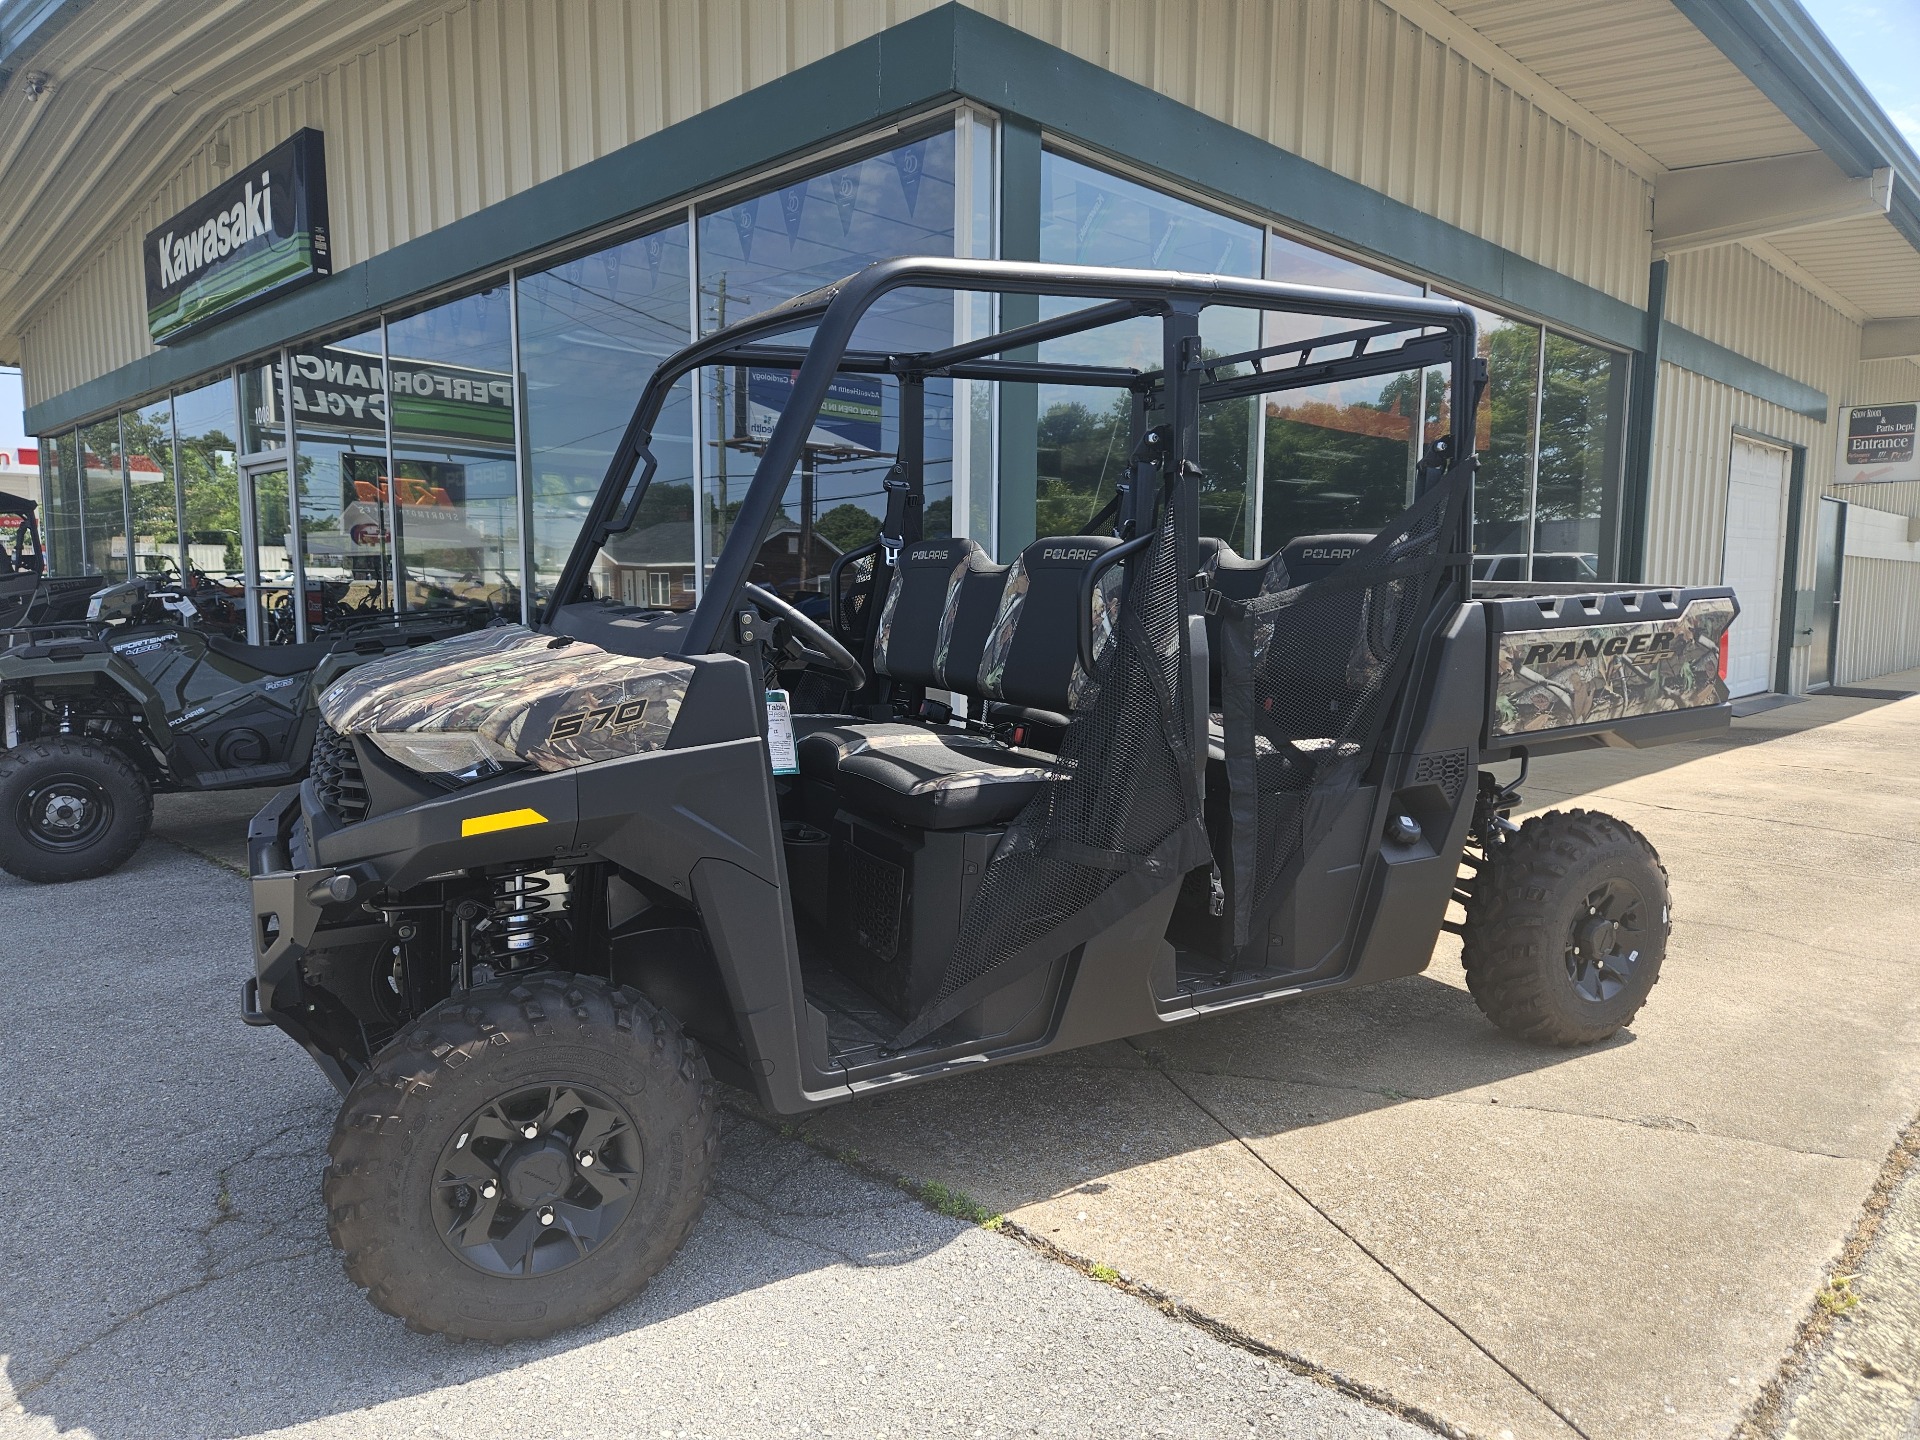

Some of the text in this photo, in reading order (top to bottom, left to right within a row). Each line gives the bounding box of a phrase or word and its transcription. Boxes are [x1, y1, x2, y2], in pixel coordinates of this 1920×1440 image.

[159, 170, 272, 290] Kawasaki
[1876, 423, 1915, 433] Parts Dept.
[1852, 437, 1909, 450] Entrance
[911, 550, 949, 561] POLARIS
[1043, 548, 1099, 561] POLARIS
[113, 633, 178, 654] SPORTSMAN
[1523, 631, 1676, 666] RANGER
[1632, 650, 1676, 667] SP
[168, 706, 205, 727] POLARIS
[548, 698, 649, 742] 570
